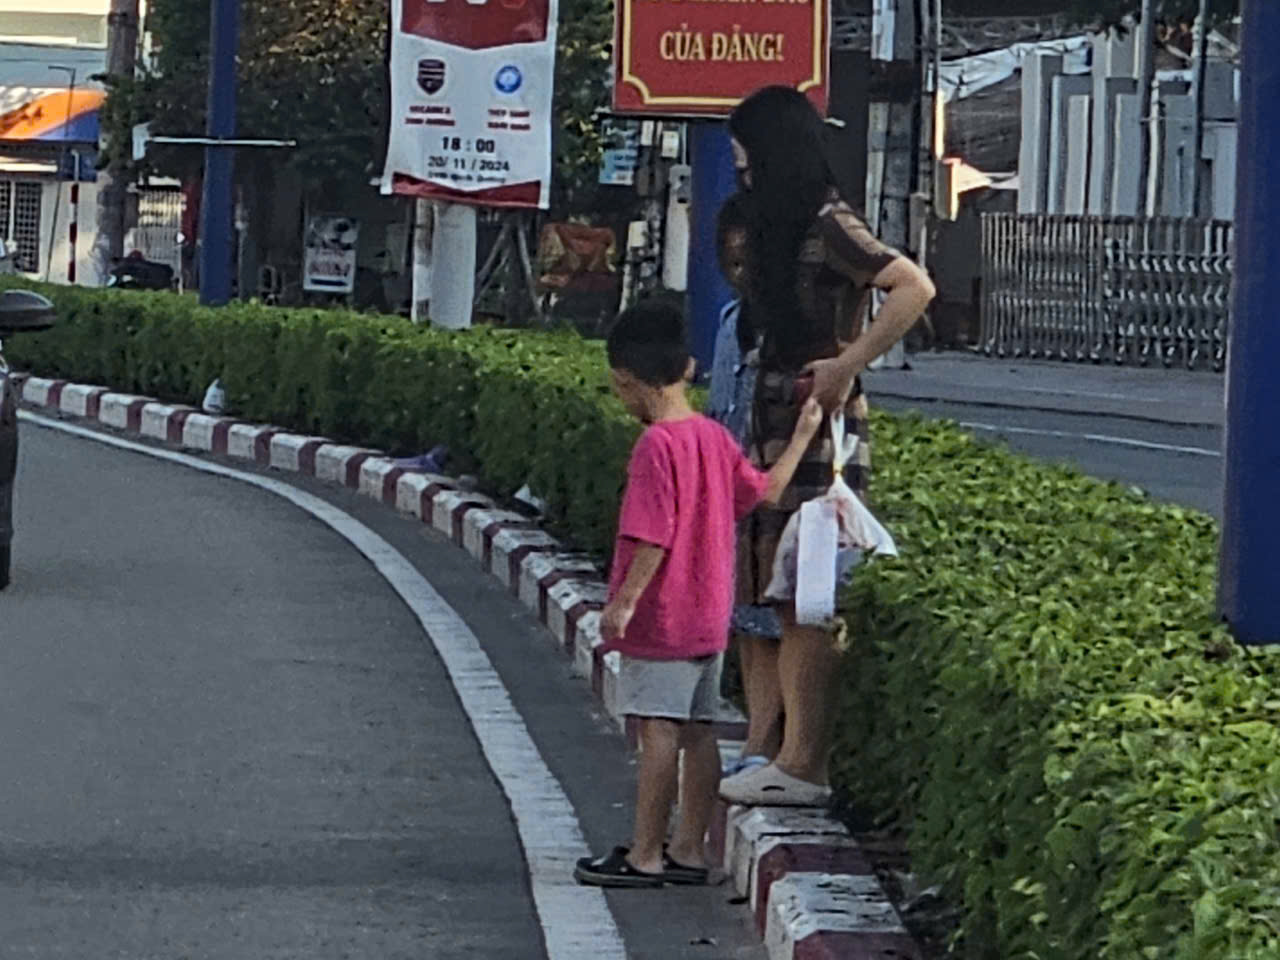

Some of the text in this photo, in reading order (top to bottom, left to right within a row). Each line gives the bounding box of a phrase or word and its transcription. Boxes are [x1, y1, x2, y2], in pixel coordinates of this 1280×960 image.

[659, 23, 784, 62] CỦA ĐẢNG!
[442, 136, 461, 150] 18
[475, 138, 495, 153] 00
[479, 159, 510, 171] 2024
